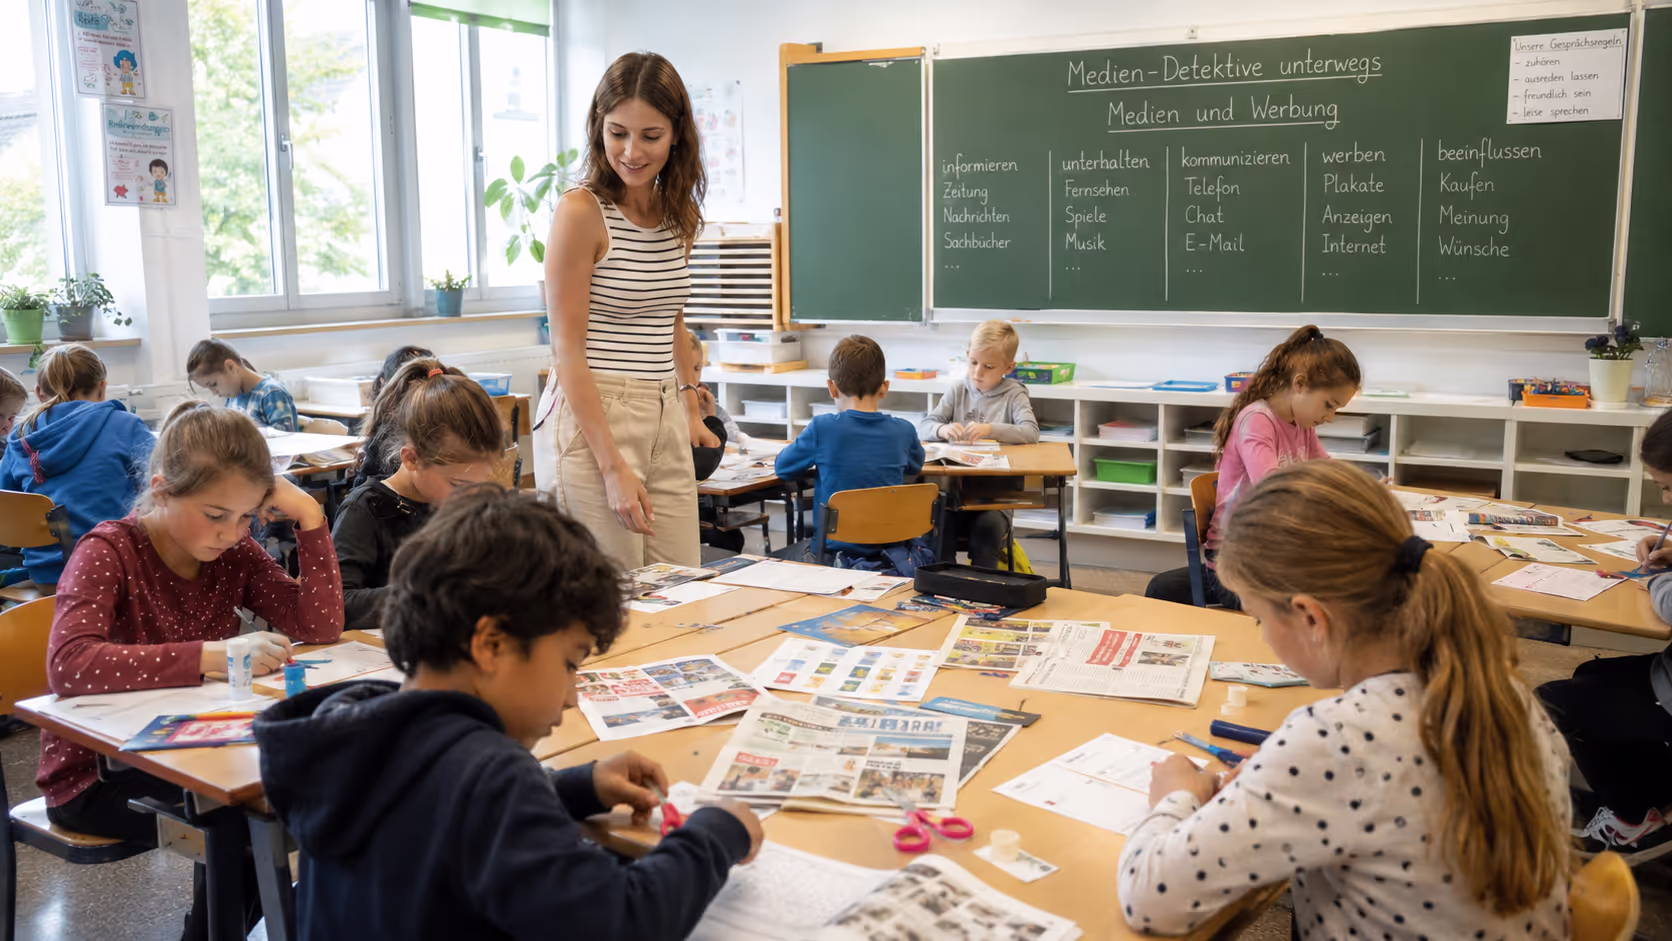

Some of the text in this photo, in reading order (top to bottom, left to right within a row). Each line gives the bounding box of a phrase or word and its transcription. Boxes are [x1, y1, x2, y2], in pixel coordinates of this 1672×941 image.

[1515, 35, 1621, 51] Unsere Gesprächsregeln
[1067, 48, 1383, 86] Medien-Detektive unterwegs
[1525, 57, 1560, 67] zuhören
[1524, 72, 1564, 83] ausreden
[1570, 71, 1599, 81] lassen
[1524, 89, 1567, 104] freundlich
[1574, 89, 1592, 97] sein
[1107, 96, 1341, 131] Medien und Werbung
[1523, 106, 1543, 117] leise
[1550, 105, 1589, 119] sprechen
[1062, 149, 1150, 171] unterhalten
[1181, 146, 1291, 168] kommunizieren
[1322, 141, 1386, 163] werben
[1438, 138, 1542, 168] beeinflussen
[942, 153, 1018, 179] informieren
[943, 181, 989, 205] Zeitung
[1065, 179, 1130, 198] Fernsehen
[1184, 175, 1241, 202] Telefon
[1323, 173, 1386, 193] Plakate
[1439, 173, 1496, 198] Kaufen
[943, 207, 1010, 223] Nachrichten
[1065, 206, 1108, 229] Spiele
[1185, 205, 1225, 224] Chat
[1322, 204, 1393, 233] Anzeigen
[1439, 204, 1510, 235] Meinung
[944, 232, 1012, 249] Sachbücher
[1065, 232, 1107, 251] Musik
[1185, 232, 1245, 252] E-Mail
[1322, 233, 1387, 254] Internet
[1438, 235, 1511, 258] Wünsche
